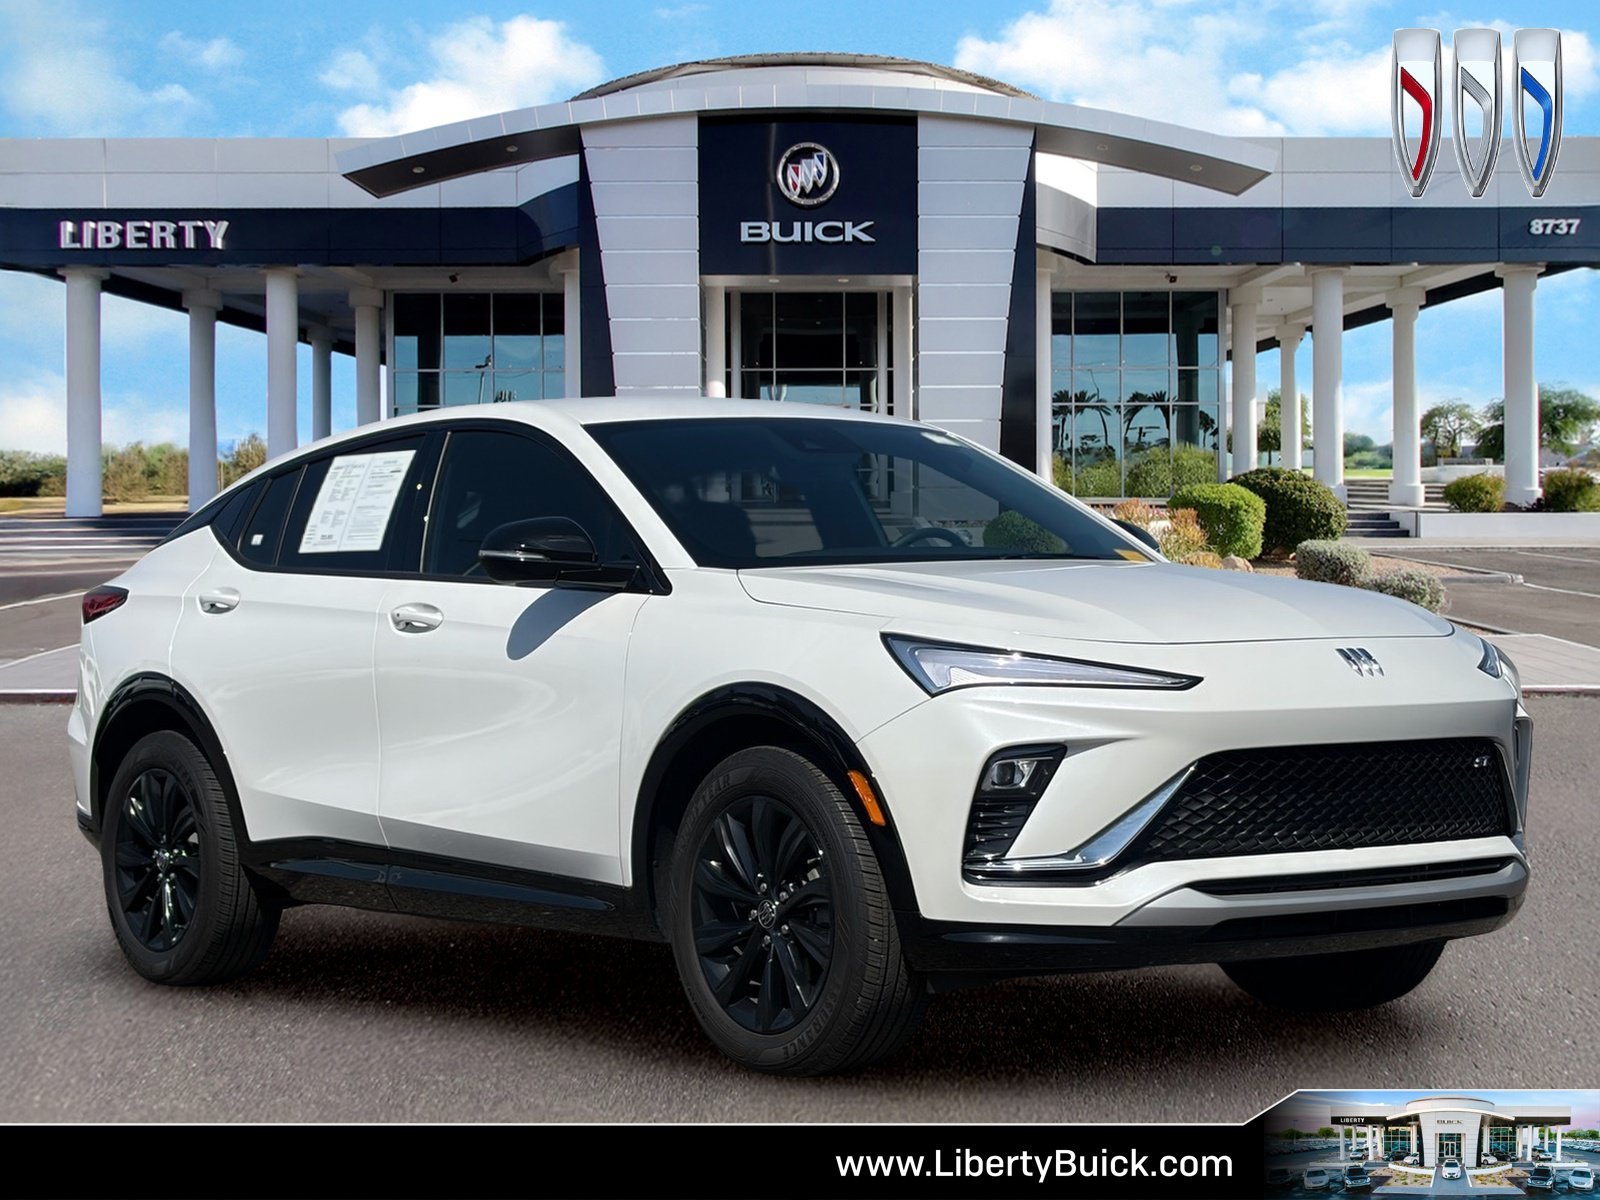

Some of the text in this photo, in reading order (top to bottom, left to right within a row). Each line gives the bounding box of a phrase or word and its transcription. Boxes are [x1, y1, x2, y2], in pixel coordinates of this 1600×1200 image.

[59, 220, 229, 249] LIBERTY
[740, 221, 876, 242] BUICK
[1529, 218, 1581, 235] 8737
